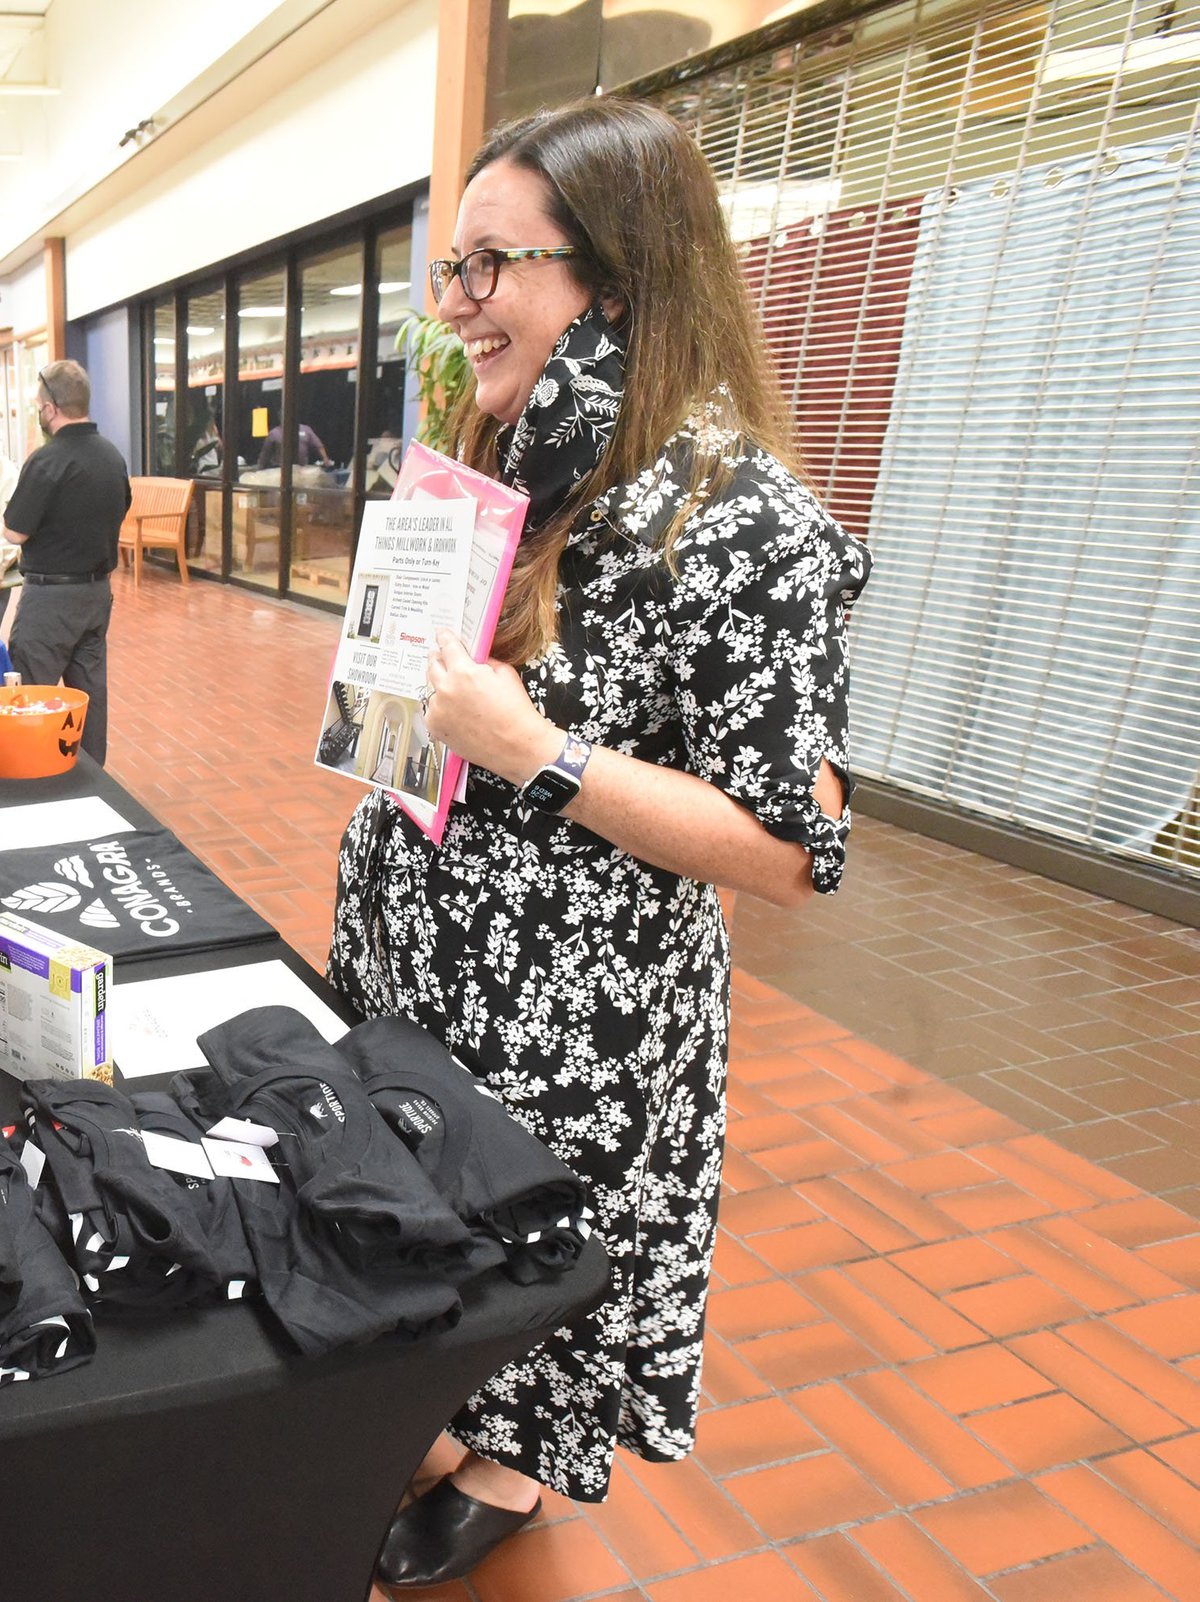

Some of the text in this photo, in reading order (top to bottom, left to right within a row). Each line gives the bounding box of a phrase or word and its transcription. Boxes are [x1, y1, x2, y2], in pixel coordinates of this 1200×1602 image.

[386, 517, 397, 531] THE
[418, 517, 439, 531] LEADER
[375, 536, 396, 551] THINGS
[395, 537, 426, 552] MILLWORK
[392, 556, 404, 564] Parts
[404, 557, 415, 566] Only
[400, 632, 425, 645] Simpson
[89, 840, 180, 937] CONAGRA
[146, 862, 192, 909] BRANDS
[96, 972, 106, 1012] gardein
[398, 1101, 432, 1134] SPORTIQE
